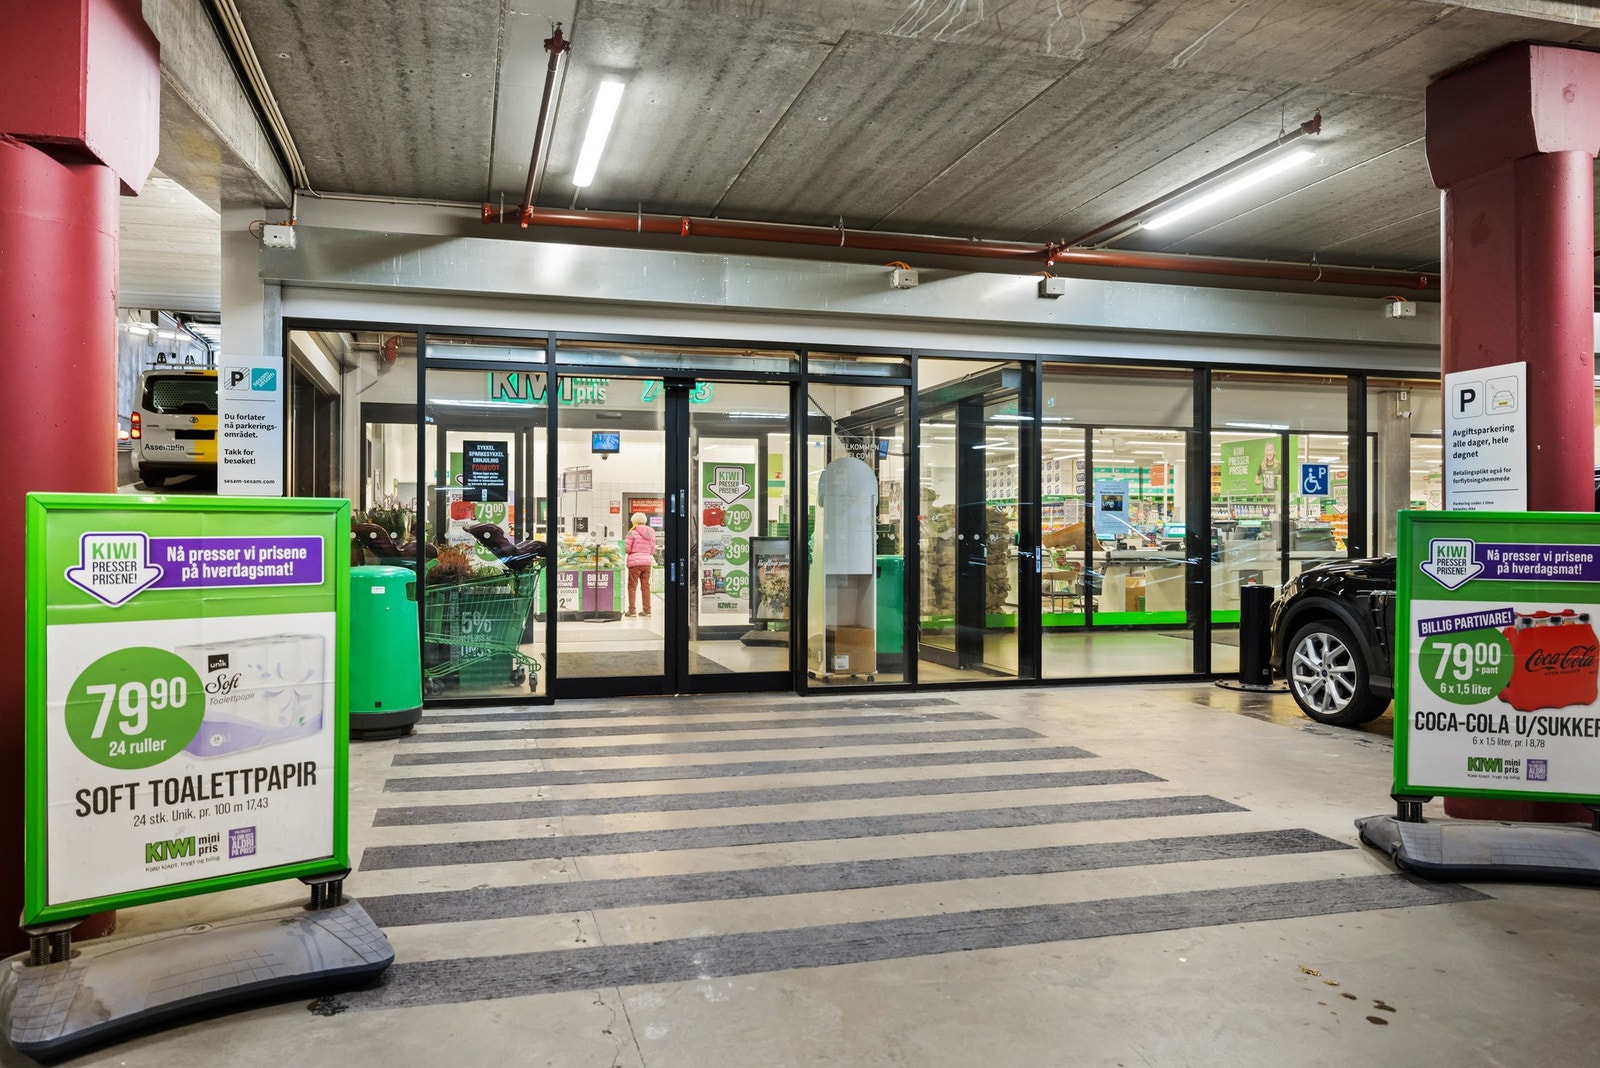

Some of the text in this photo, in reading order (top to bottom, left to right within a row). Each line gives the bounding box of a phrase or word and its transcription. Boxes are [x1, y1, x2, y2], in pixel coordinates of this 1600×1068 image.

[231, 371, 244, 386] P
[491, 372, 573, 401] KIWI
[576, 383, 607, 402] pris
[1460, 388, 1476, 412] P
[236, 422, 277, 432] parkerings-
[1452, 424, 1515, 438] Avgiftsparkering
[224, 430, 258, 438] området.
[1452, 440, 1466, 448] alle
[1467, 438, 1490, 448] dager,
[1452, 450, 1478, 460] døgnet
[719, 472, 739, 480] KIWI
[1319, 468, 1326, 478] P
[1453, 469, 1489, 477] Betalingsplikt
[1453, 476, 1510, 484] forflytningshemmede
[92, 542, 137, 560] KIWI
[167, 546, 307, 564] Nå presser vi prisene
[1437, 545, 1467, 558] KIWI
[1487, 549, 1593, 564] Nå presser vi prisene
[92, 561, 137, 572] PRESSER
[1437, 558, 1467, 567] PRESSER
[182, 562, 293, 582] på hverdagsmat!
[1437, 567, 1467, 576] PRISENE!
[1497, 563, 1582, 576] på hverdagsmat!
[92, 573, 137, 585] PRISENE!
[1421, 612, 1512, 634] BILLIG PARTIVARE!
[210, 659, 227, 668] unik
[1481, 667, 1498, 675] pant
[205, 673, 242, 695] Soft
[1440, 683, 1447, 693] 6
[1458, 683, 1470, 695] 1,5
[1472, 684, 1492, 695] liter
[209, 692, 255, 706] Toalettpapir
[1415, 711, 1509, 734] COCA-COLA
[109, 737, 167, 756] 24 ruller
[1486, 737, 1495, 746] 1,5
[1497, 738, 1513, 747] liter,
[1514, 740, 1524, 748] pr.
[1530, 739, 1545, 748] 8,78
[1468, 757, 1503, 773] KIWI
[75, 761, 317, 818] SOFT TOALETTPAPIR
[133, 798, 269, 827] 24 stk. Unik, pr. 100 m 17,43
[145, 832, 220, 864] KIWI mini
[199, 844, 218, 856] pris
[232, 838, 254, 849] ALDRI
